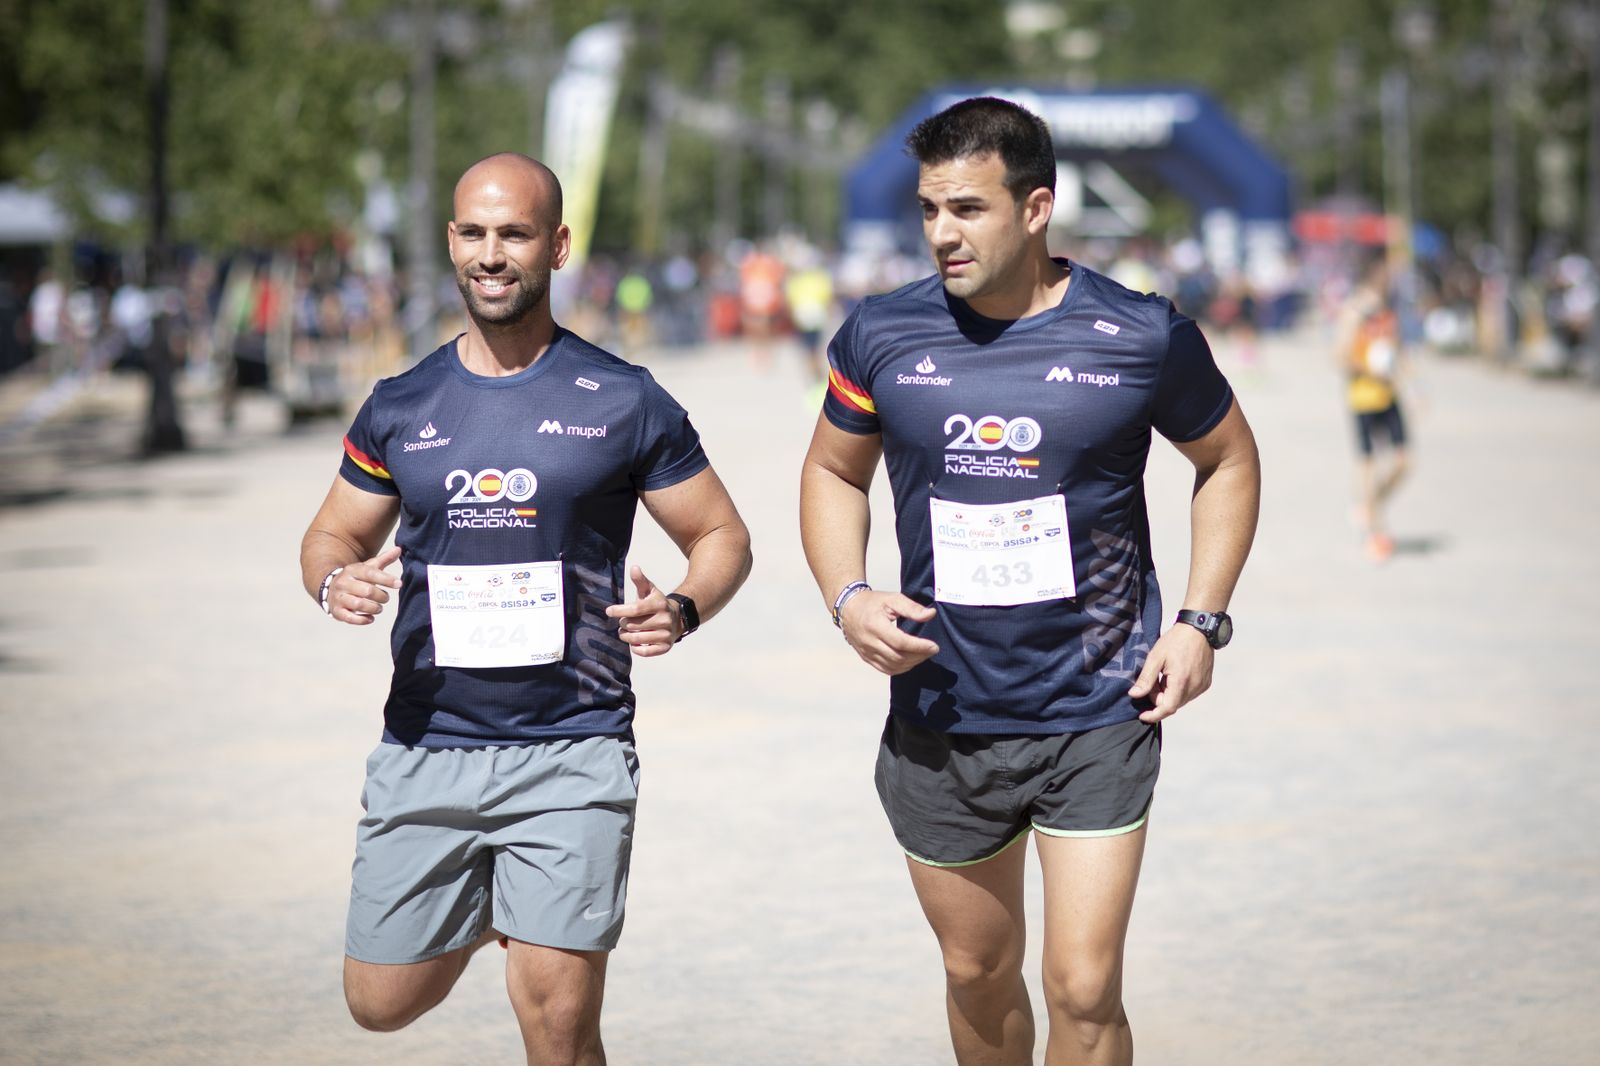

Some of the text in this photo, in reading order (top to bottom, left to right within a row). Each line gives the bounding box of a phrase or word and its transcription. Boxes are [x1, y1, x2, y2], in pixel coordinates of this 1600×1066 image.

[896, 373, 952, 386] Santander
[1077, 372, 1119, 387] mupol
[567, 424, 607, 439] mupol
[944, 413, 1042, 452] 200
[403, 437, 451, 452] Santander
[945, 454, 1020, 467] POLICIA
[945, 465, 1039, 479] NACIONAL
[445, 468, 538, 504] 200
[447, 508, 519, 519] POLICIA
[449, 518, 537, 529] NACIONAL
[938, 524, 966, 539] alsa
[971, 561, 1033, 588] 433
[436, 588, 465, 601] alsa
[469, 624, 529, 648] 424
